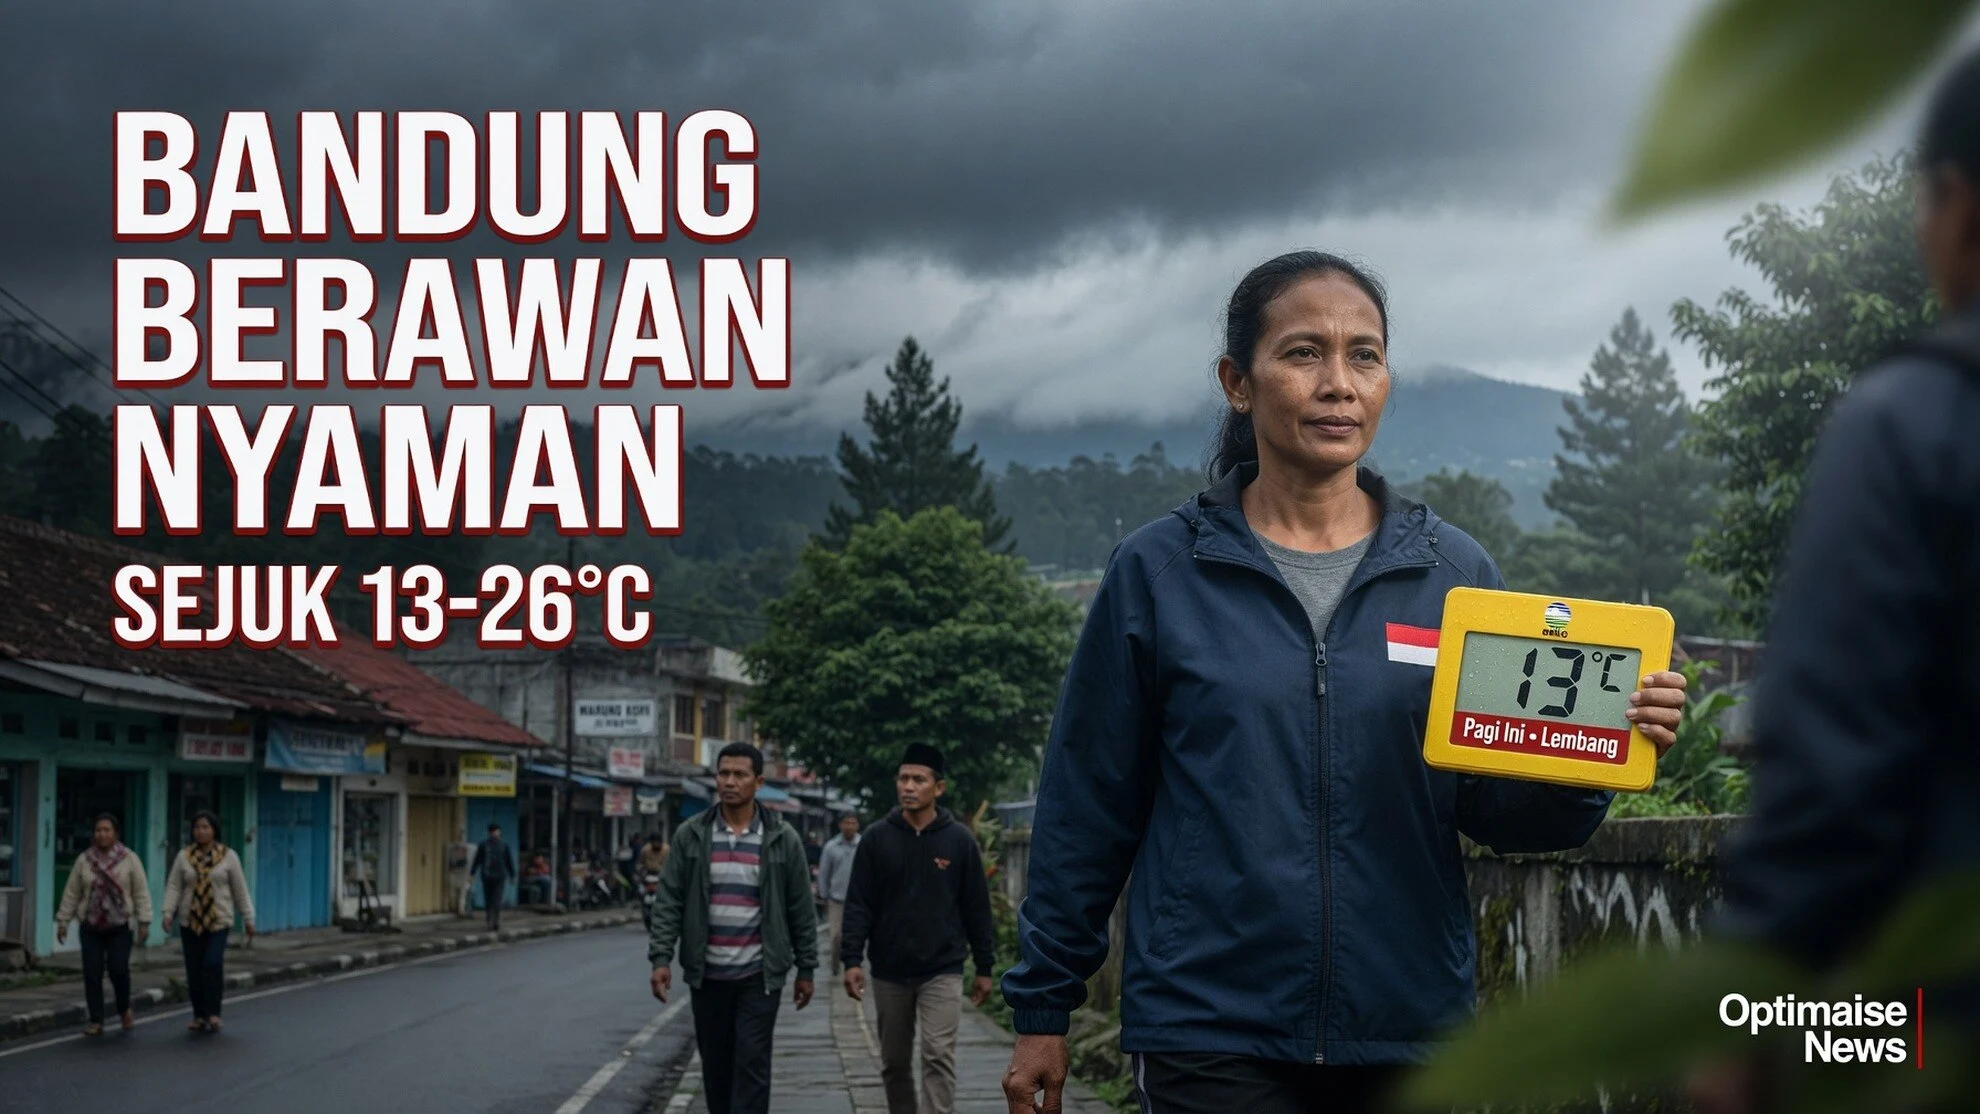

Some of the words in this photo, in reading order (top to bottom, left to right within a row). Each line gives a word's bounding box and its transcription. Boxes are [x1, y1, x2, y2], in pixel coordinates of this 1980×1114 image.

[1463, 717, 1500, 745] Pagi
[1503, 722, 1524, 744] Ini
[1541, 732, 1619, 759] Lembang
